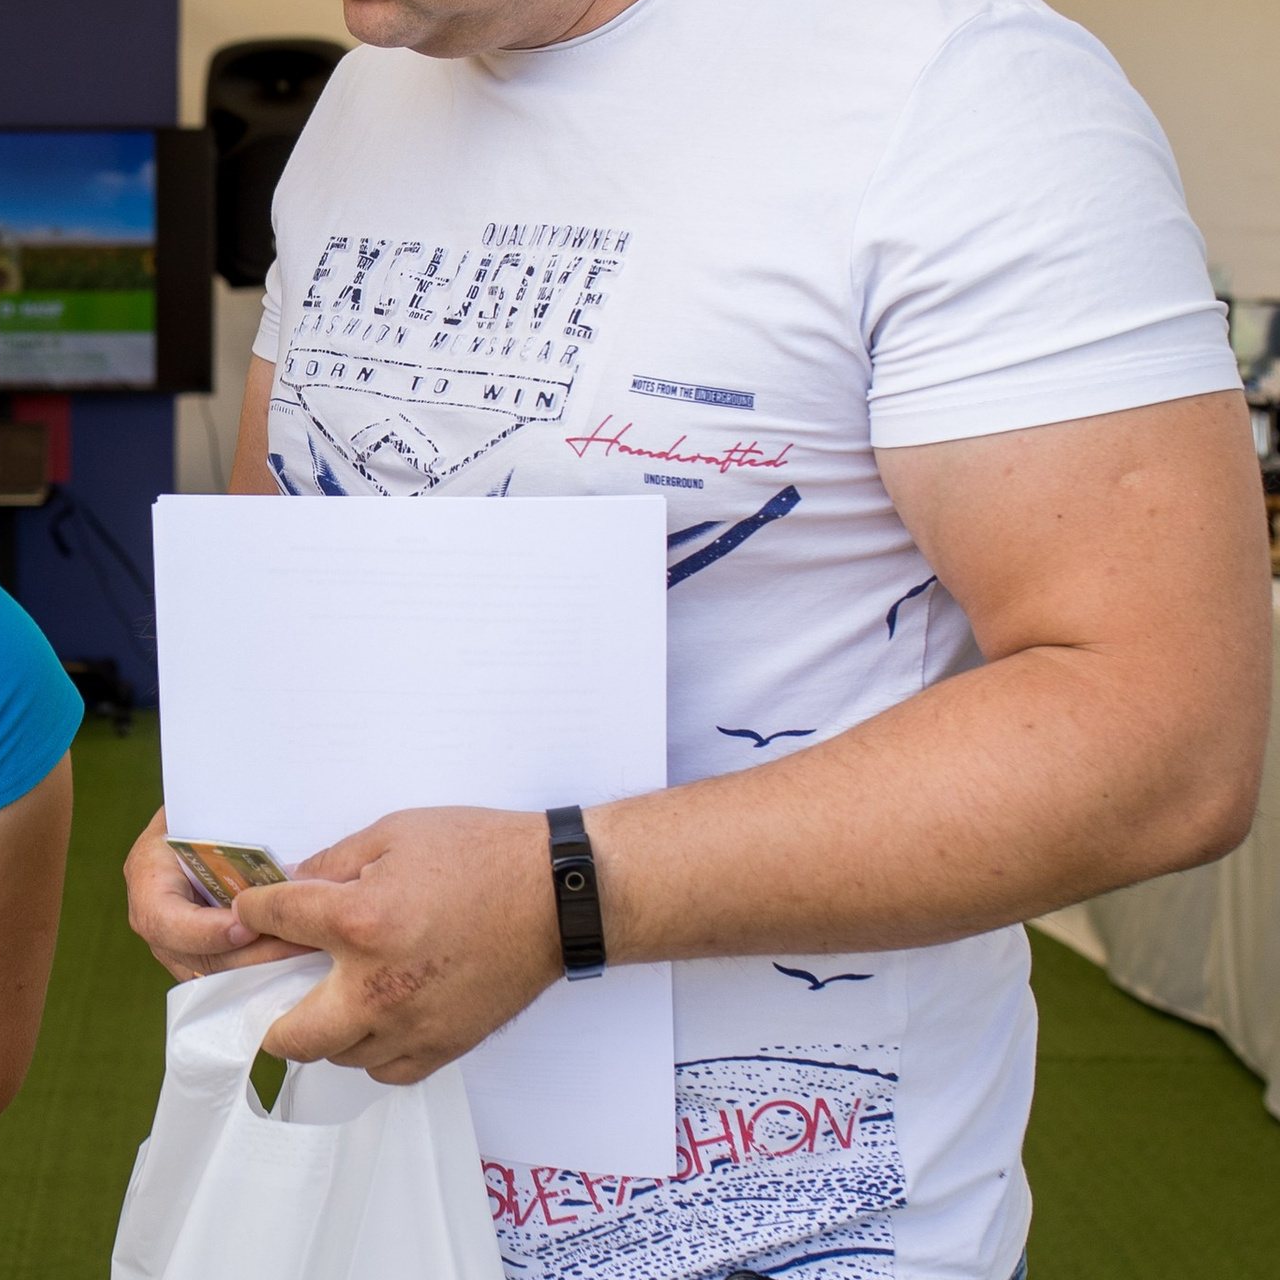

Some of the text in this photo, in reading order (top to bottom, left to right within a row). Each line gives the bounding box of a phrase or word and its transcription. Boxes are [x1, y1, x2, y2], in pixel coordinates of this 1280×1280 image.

[410, 375, 451, 395] TO
[482, 383, 557, 410] WIN
[631, 378, 755, 408] NOTES FROM THE UNDERGROUND
[565, 414, 794, 474] Handcrafted
[643, 472, 705, 490] UNDERGROUND
